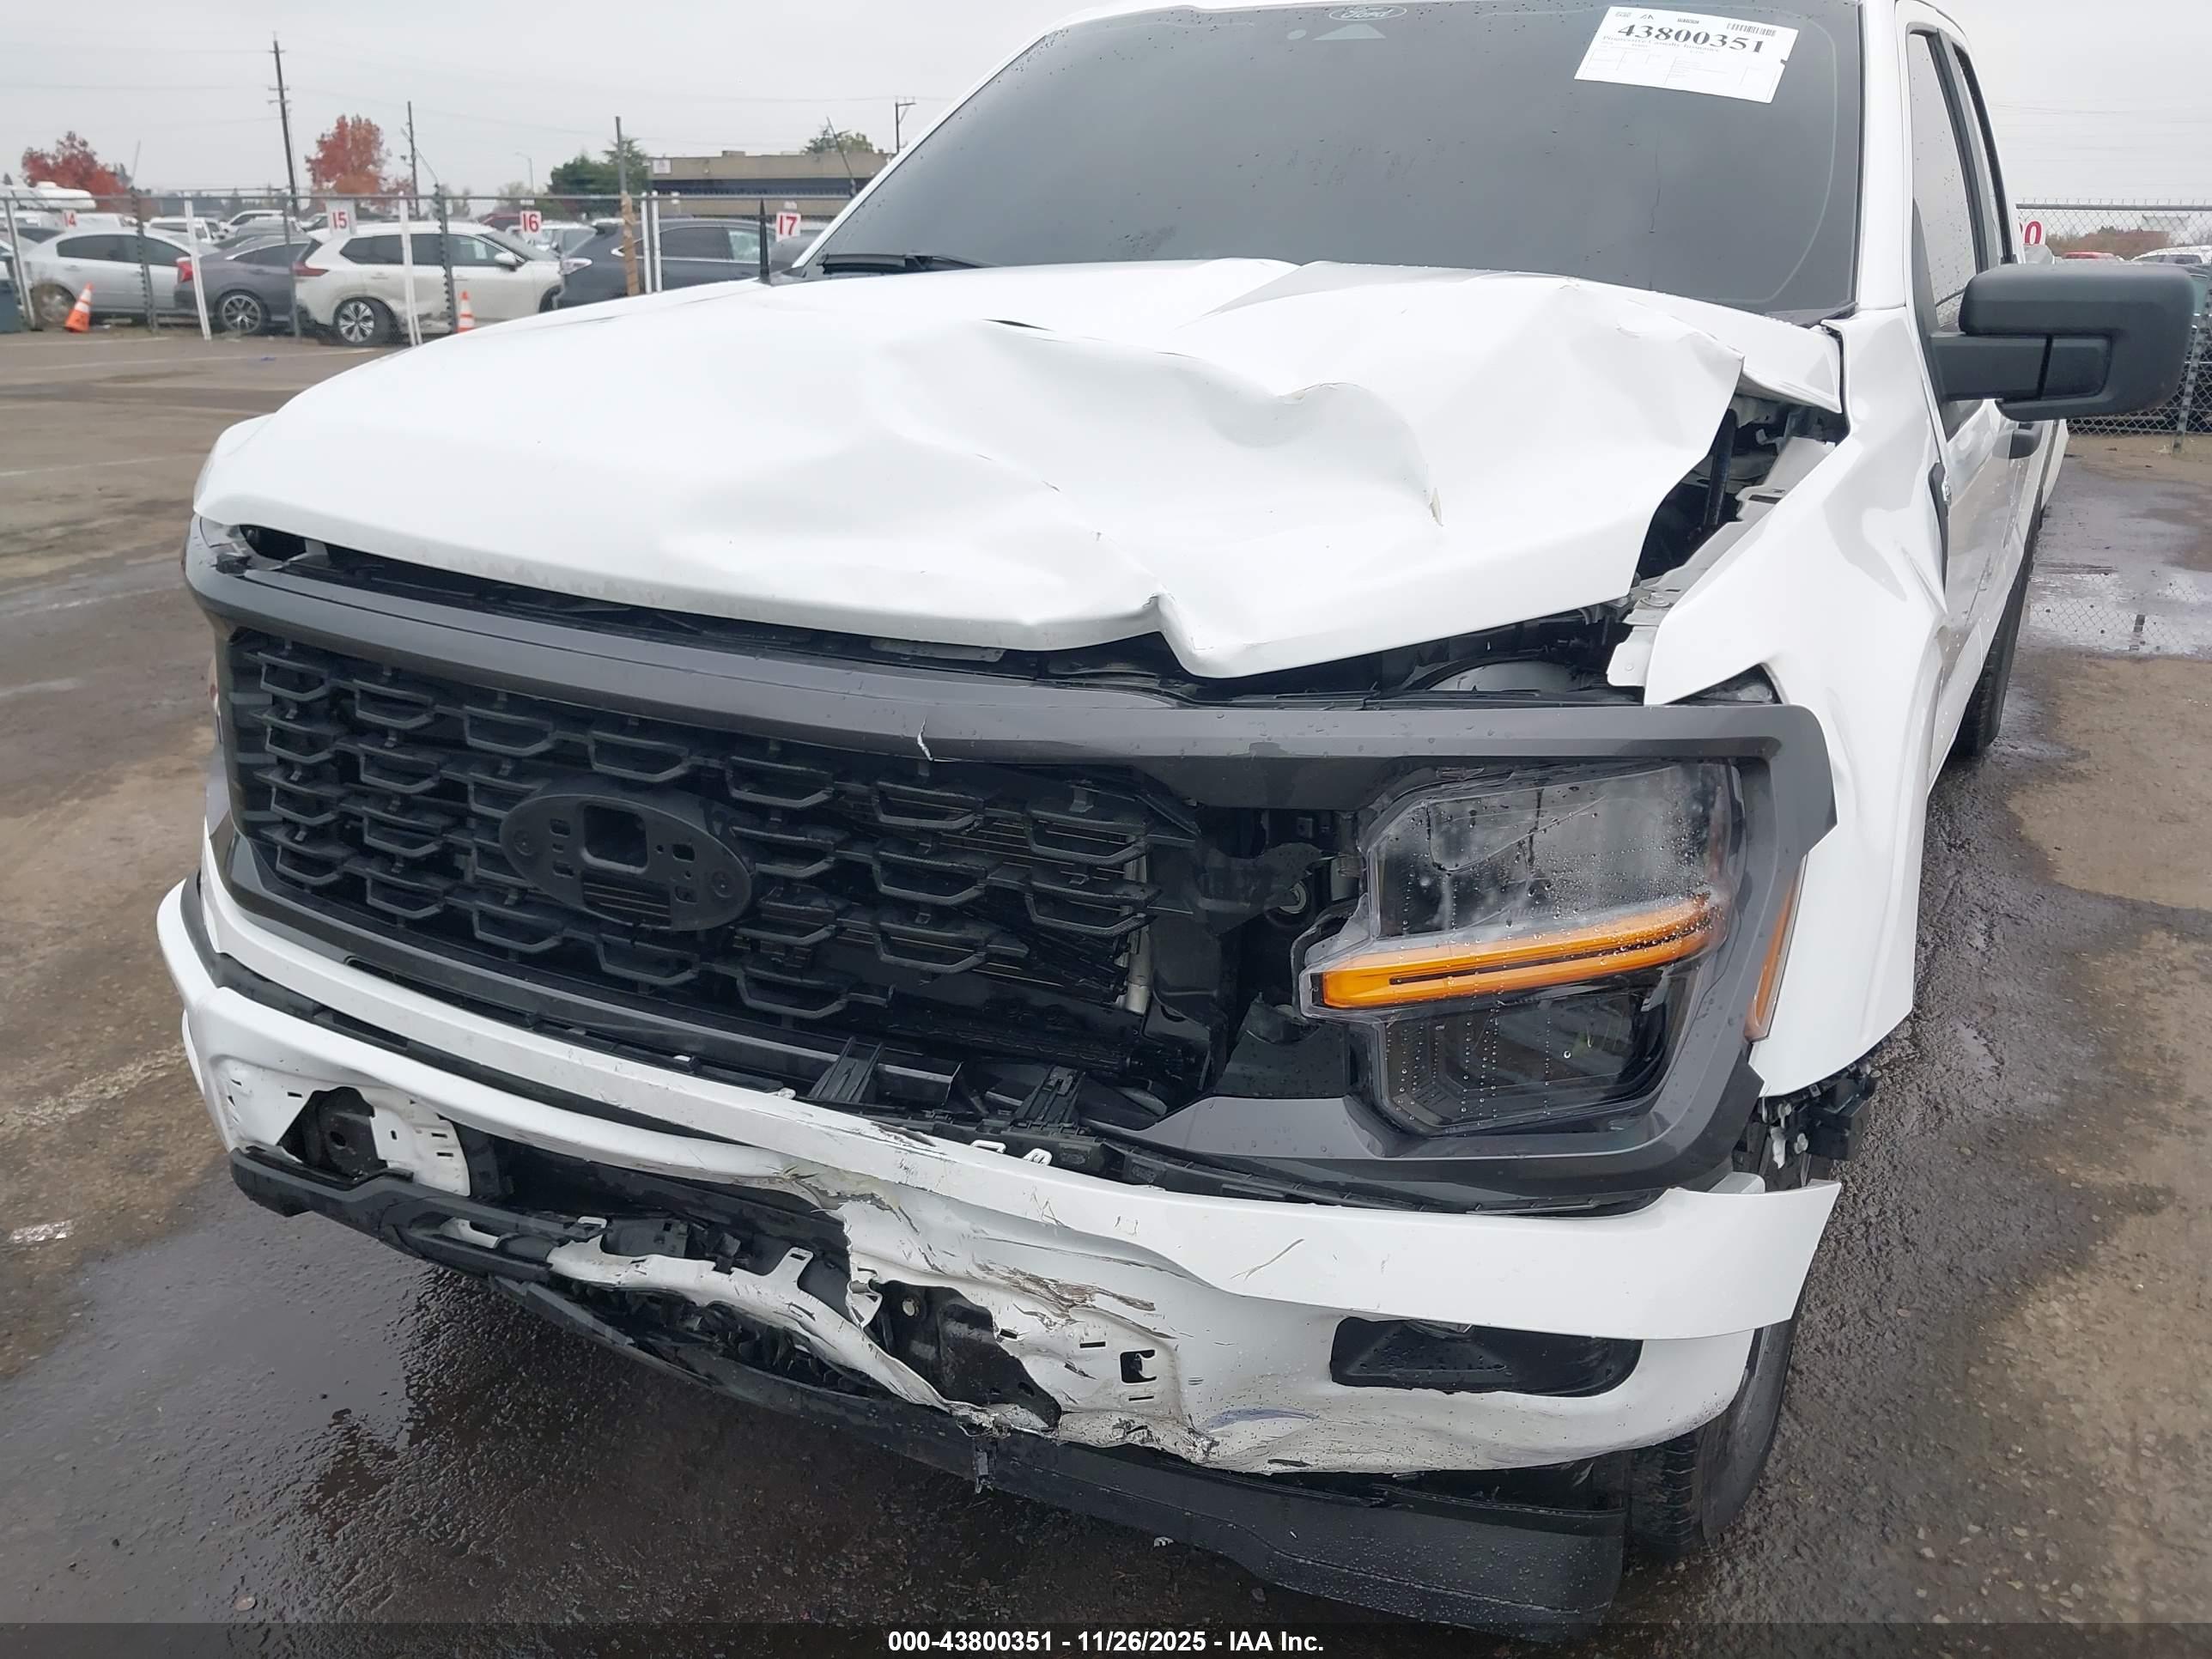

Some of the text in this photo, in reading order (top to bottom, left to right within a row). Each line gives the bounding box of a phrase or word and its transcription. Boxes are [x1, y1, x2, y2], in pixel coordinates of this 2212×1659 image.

[1617, 24, 1764, 53] 43800351
[64, 212, 77, 228] 14
[332, 211, 348, 230] 15
[522, 213, 539, 233] 16
[779, 215, 798, 236] 17
[2019, 221, 2042, 246] 0
